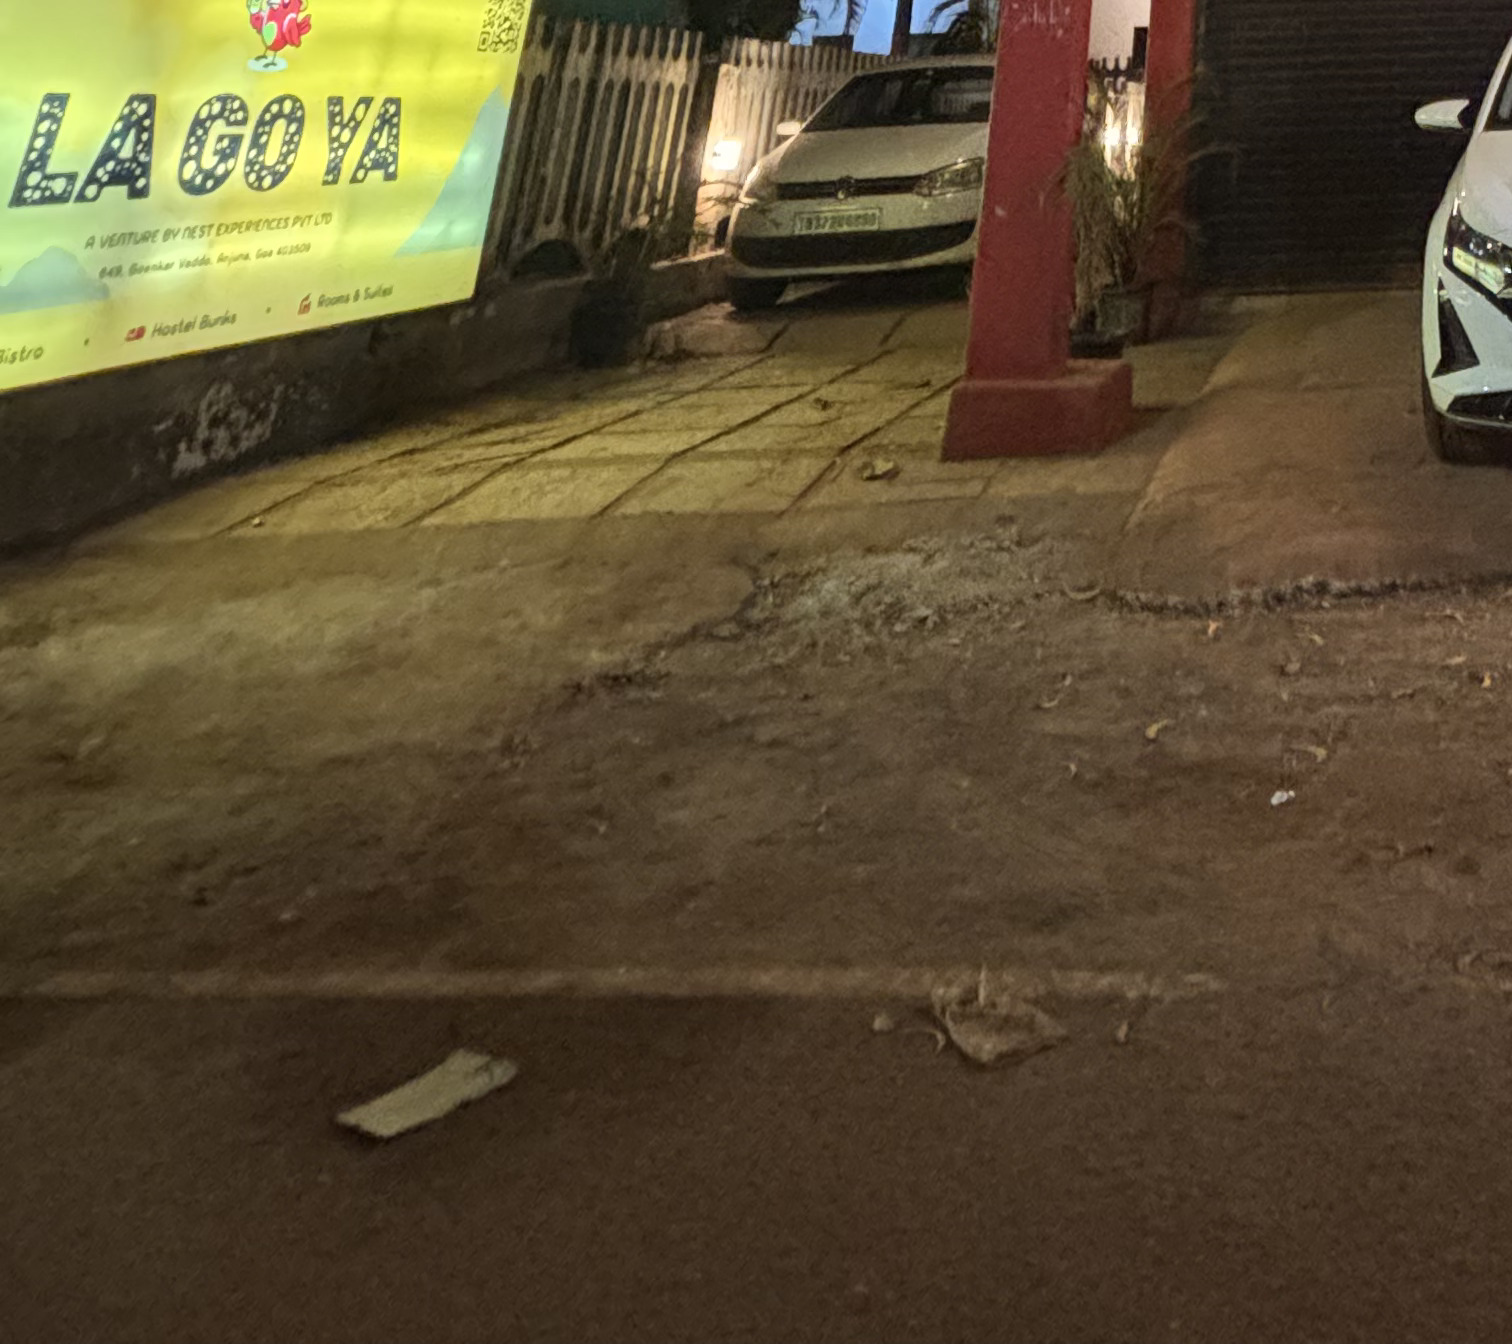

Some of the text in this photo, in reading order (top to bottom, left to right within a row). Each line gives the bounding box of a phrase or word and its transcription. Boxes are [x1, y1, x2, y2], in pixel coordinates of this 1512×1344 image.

[84, 212, 333, 250] A VENTURE BY NEST EXPERIENCES PVT LTD
[151, 319, 198, 339] Hostel
[198, 310, 238, 331] Bunks
